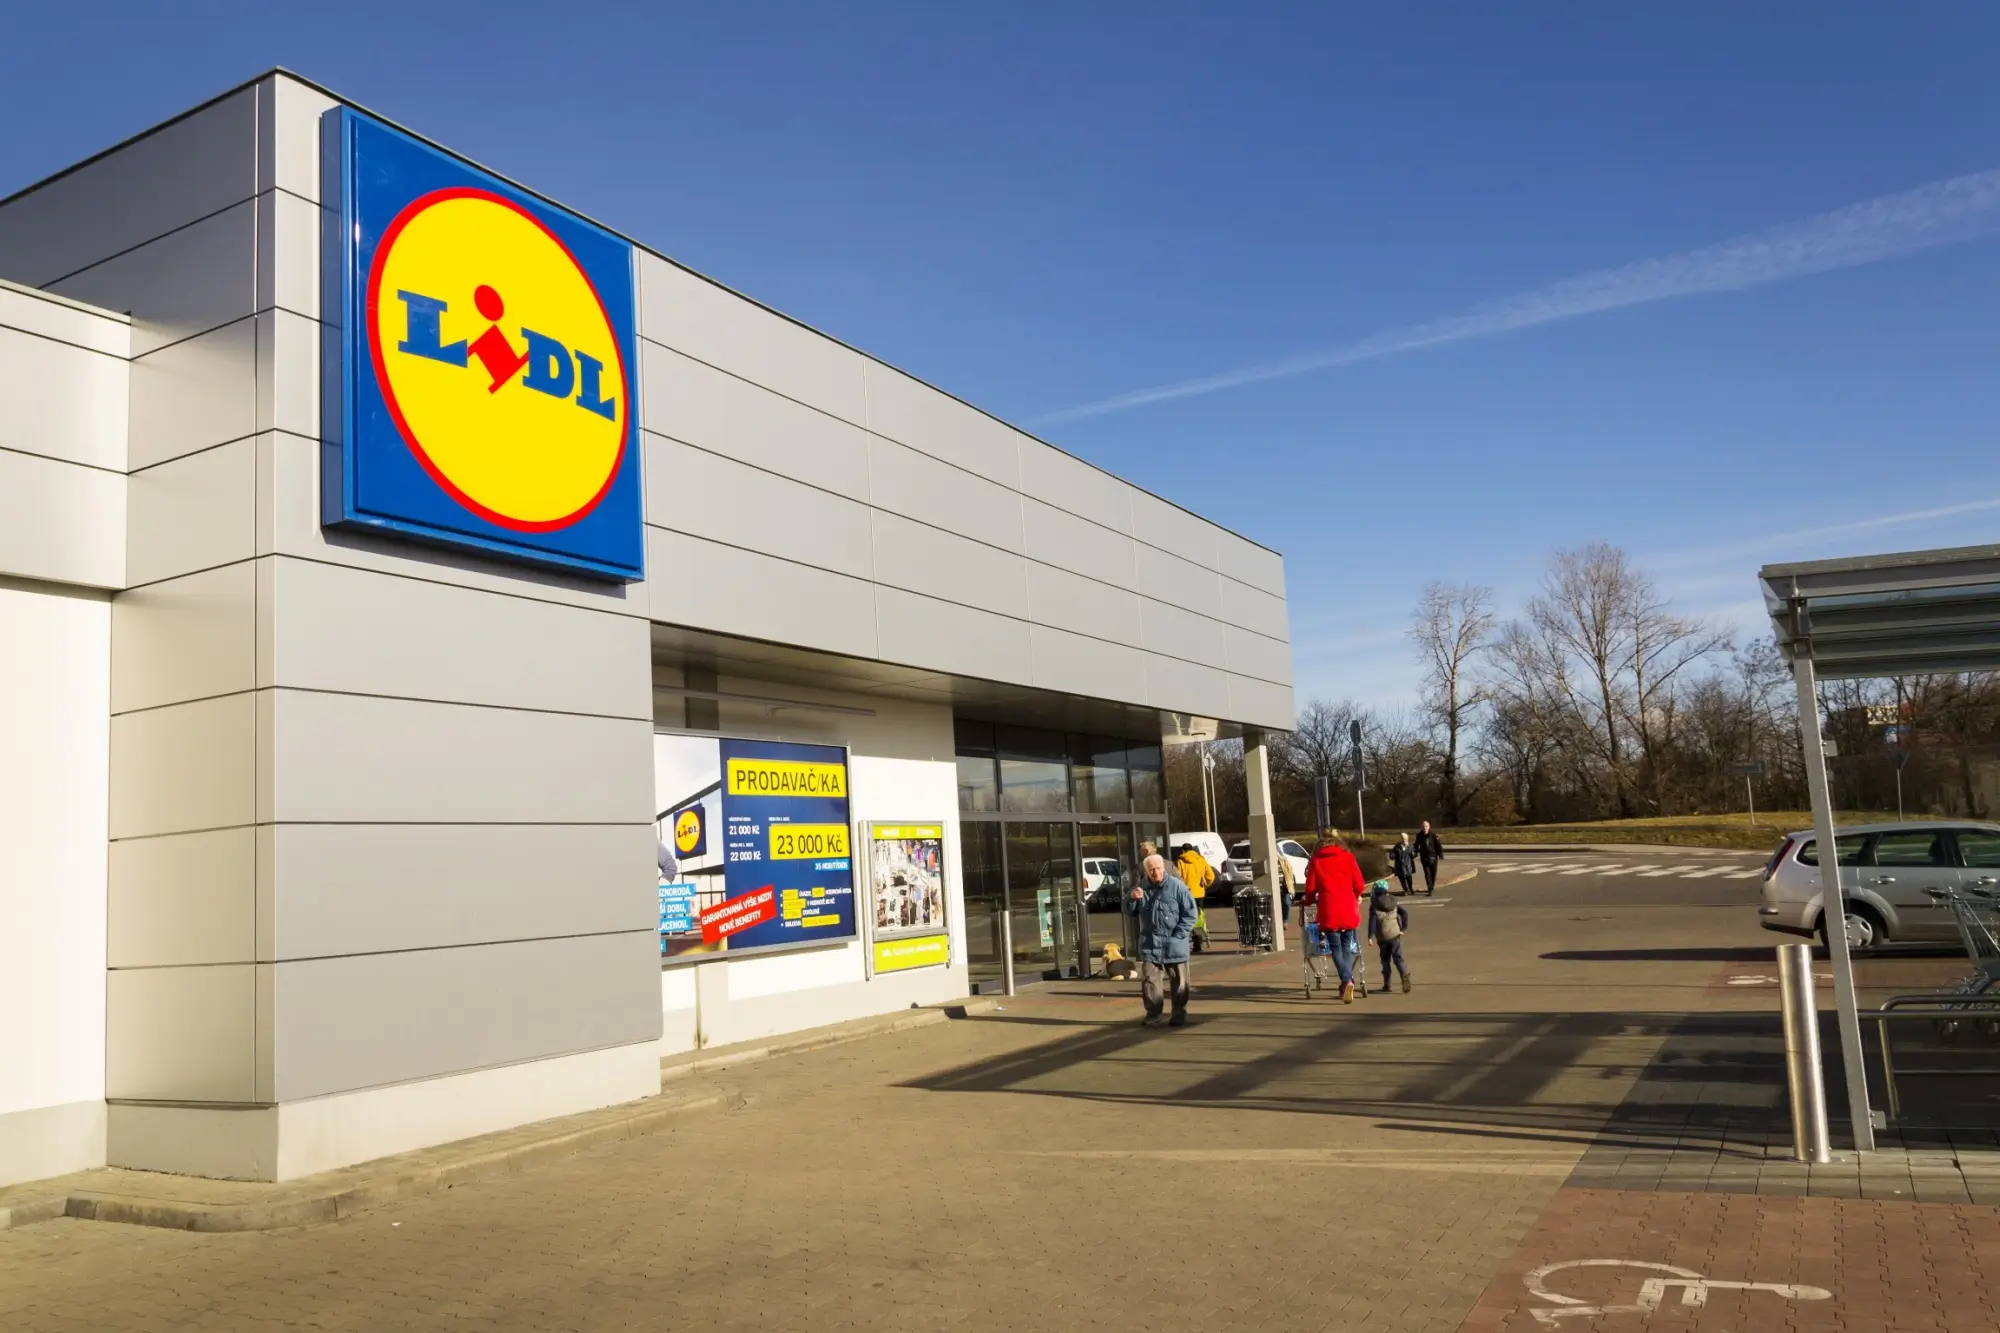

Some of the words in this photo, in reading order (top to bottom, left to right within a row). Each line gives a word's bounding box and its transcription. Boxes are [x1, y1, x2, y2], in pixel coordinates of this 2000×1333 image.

[736, 768, 840, 793] PRODAVAČ/KA
[729, 825, 738, 835] 21
[738, 825, 752, 835] 000
[752, 824, 760, 835] Kč
[777, 834, 794, 855] 23
[798, 834, 823, 854] 000
[827, 833, 843, 853] Kč
[730, 852, 739, 861] 22
[739, 851, 753, 861] 000
[753, 851, 761, 861] Kč
[701, 900, 743, 925] GARANTOVANÁ
[719, 918, 735, 934] NOVÉ
[735, 909, 761, 927] BENEFITY
